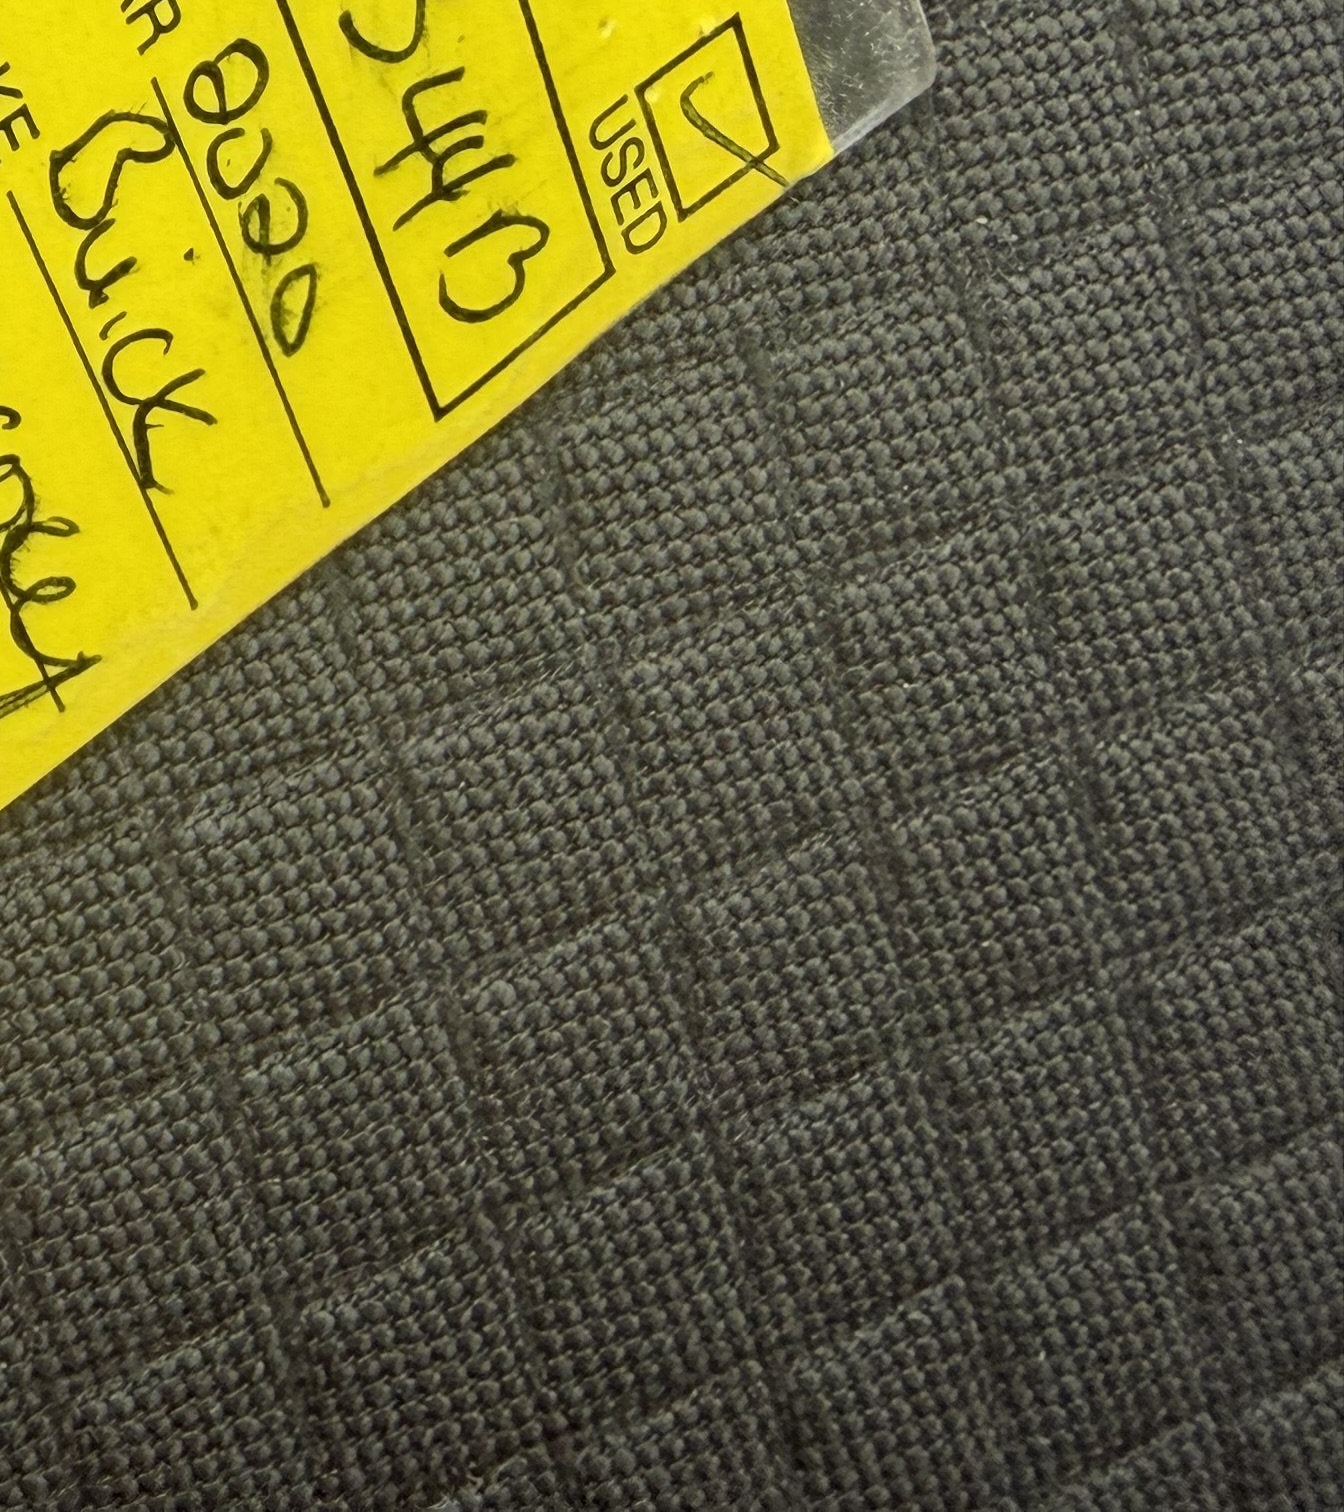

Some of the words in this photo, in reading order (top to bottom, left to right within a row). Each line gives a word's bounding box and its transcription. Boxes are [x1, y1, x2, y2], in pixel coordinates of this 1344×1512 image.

[50, 112, 214, 490] Buick
[184, 39, 317, 356] 2020
[590, 97, 666, 254] USED
